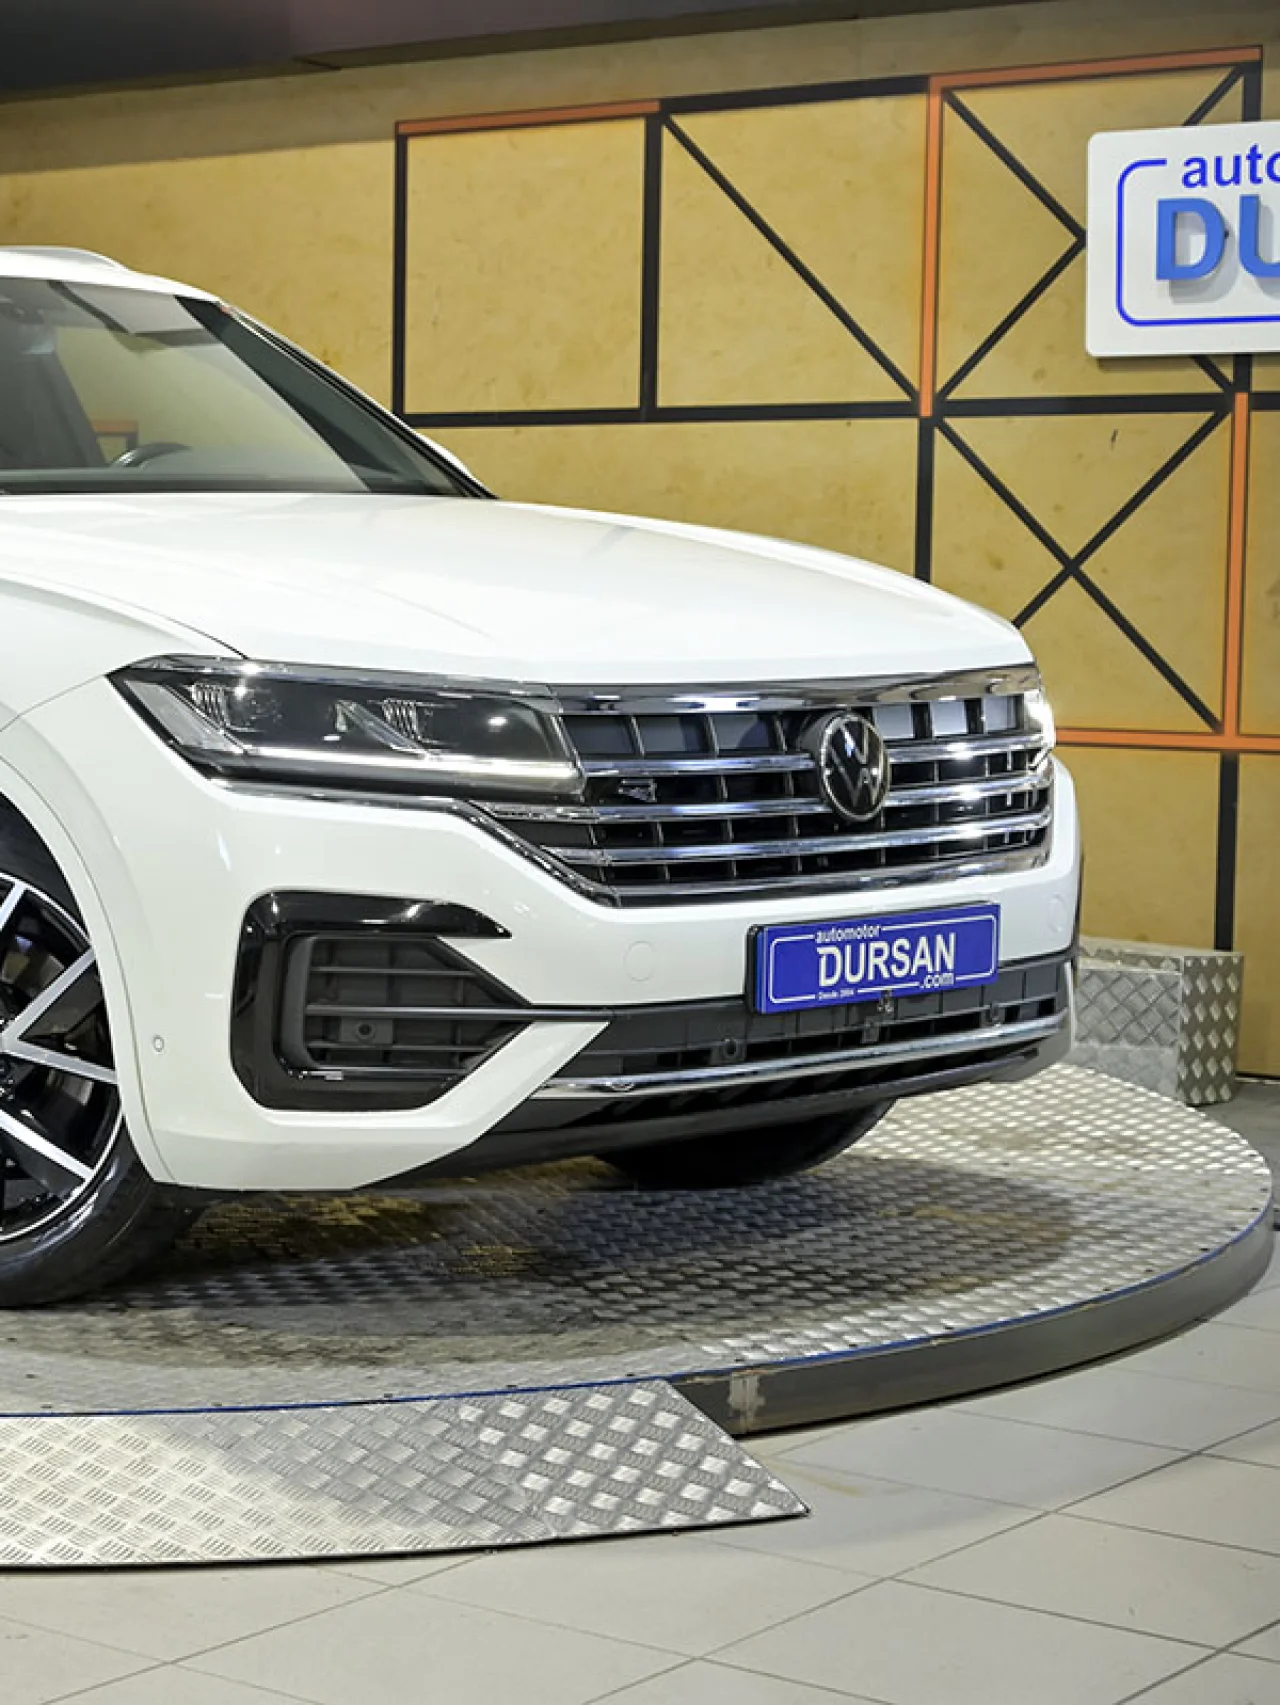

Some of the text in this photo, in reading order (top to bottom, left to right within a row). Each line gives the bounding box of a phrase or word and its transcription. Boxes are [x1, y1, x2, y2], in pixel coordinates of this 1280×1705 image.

[815, 924, 880, 943] automotor
[816, 931, 957, 987] DURSAN
[919, 971, 955, 989] .com
